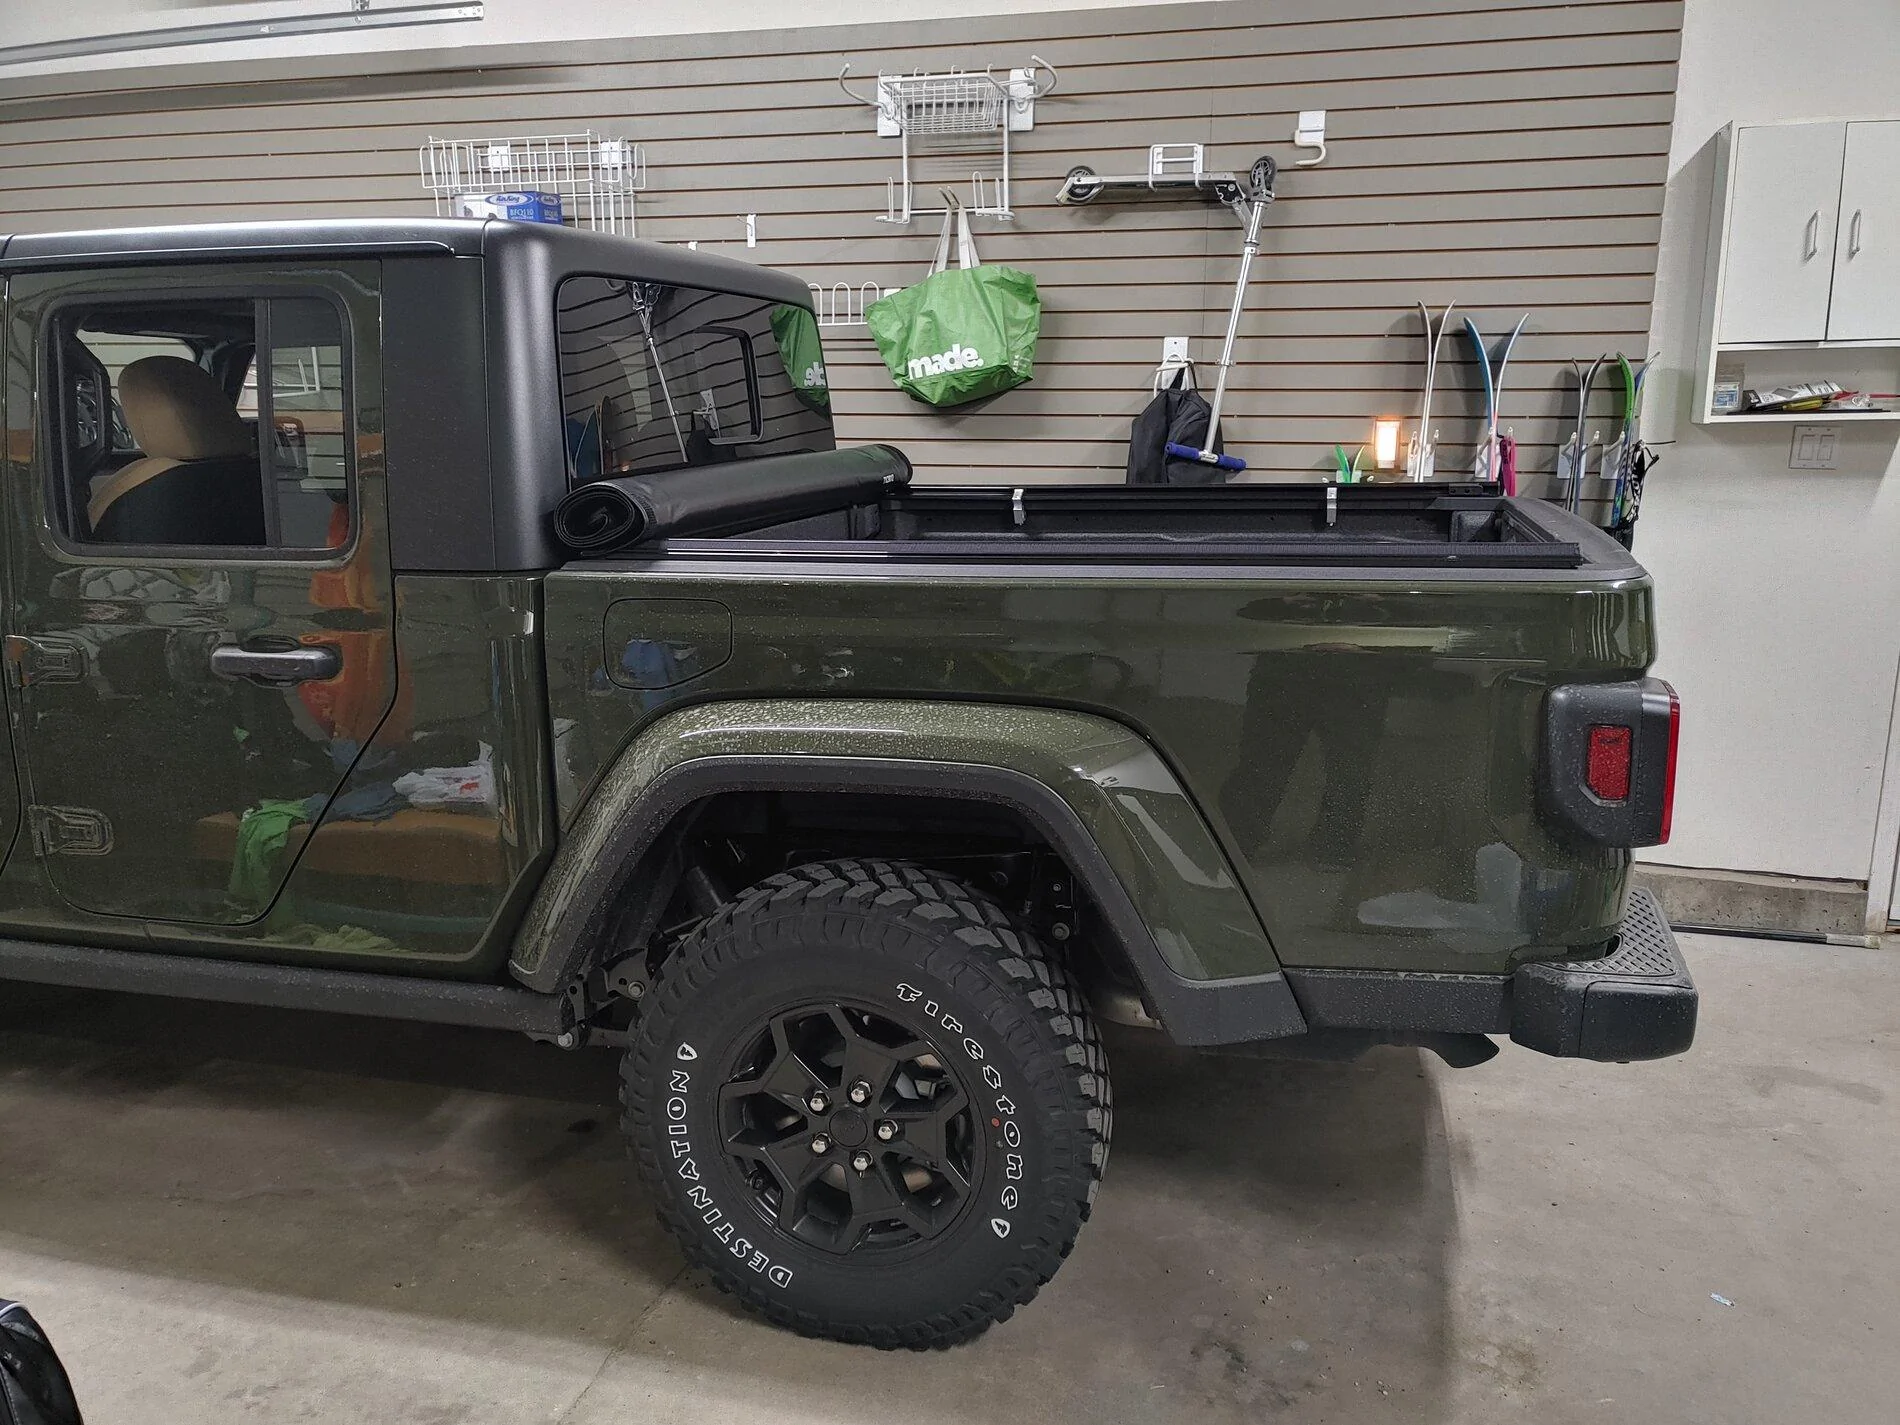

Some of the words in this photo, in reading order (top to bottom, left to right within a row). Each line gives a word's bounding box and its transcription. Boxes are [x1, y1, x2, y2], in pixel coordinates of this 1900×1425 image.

[908, 343, 984, 380] made.
[666, 1069, 793, 1288] DESTINATION
[896, 982, 1024, 1210] Firestone
